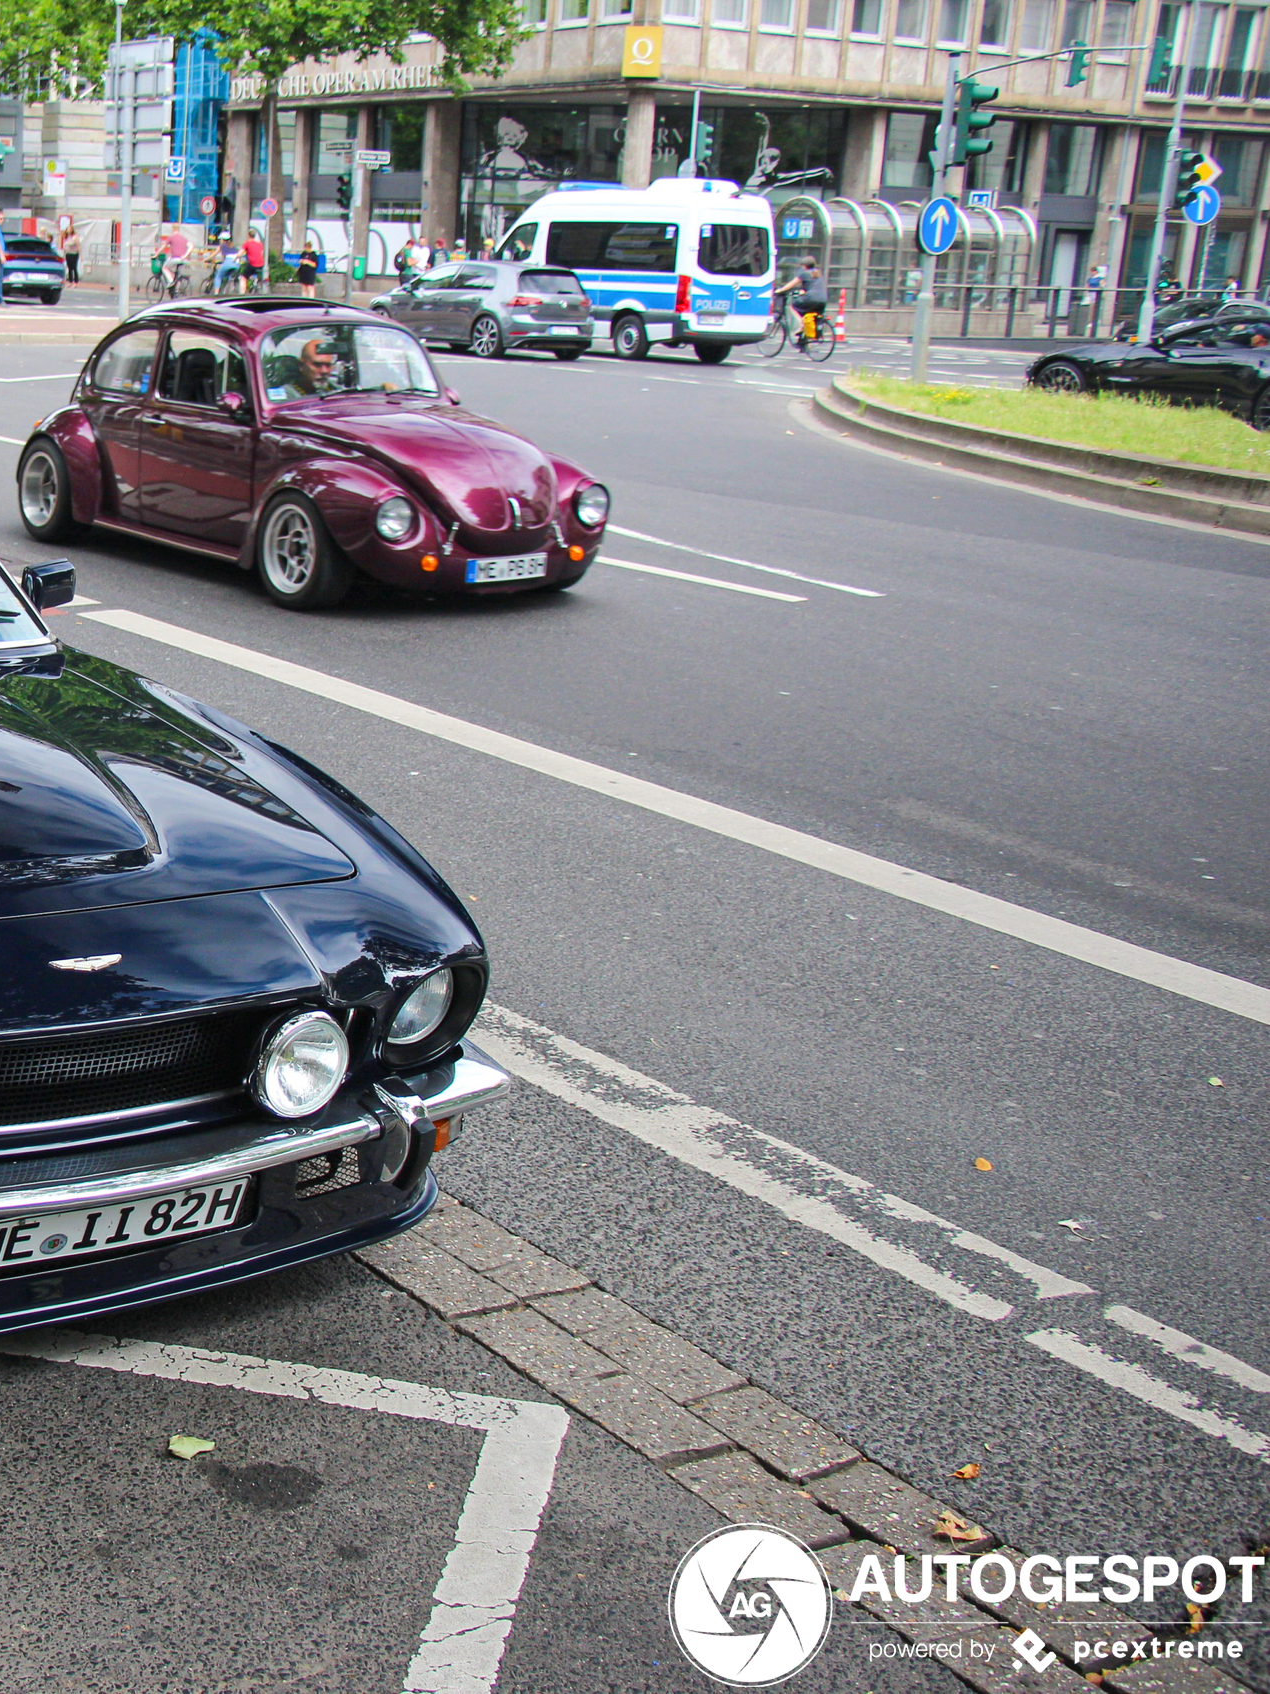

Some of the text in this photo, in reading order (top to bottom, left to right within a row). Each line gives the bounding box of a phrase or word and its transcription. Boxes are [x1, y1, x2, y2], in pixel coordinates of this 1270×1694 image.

[630, 38, 654, 65] Q
[311, 69, 356, 96] OPER
[355, 67, 387, 92] AM
[696, 299, 731, 310] POLIZEI
[143, 1183, 243, 1237] 82H
